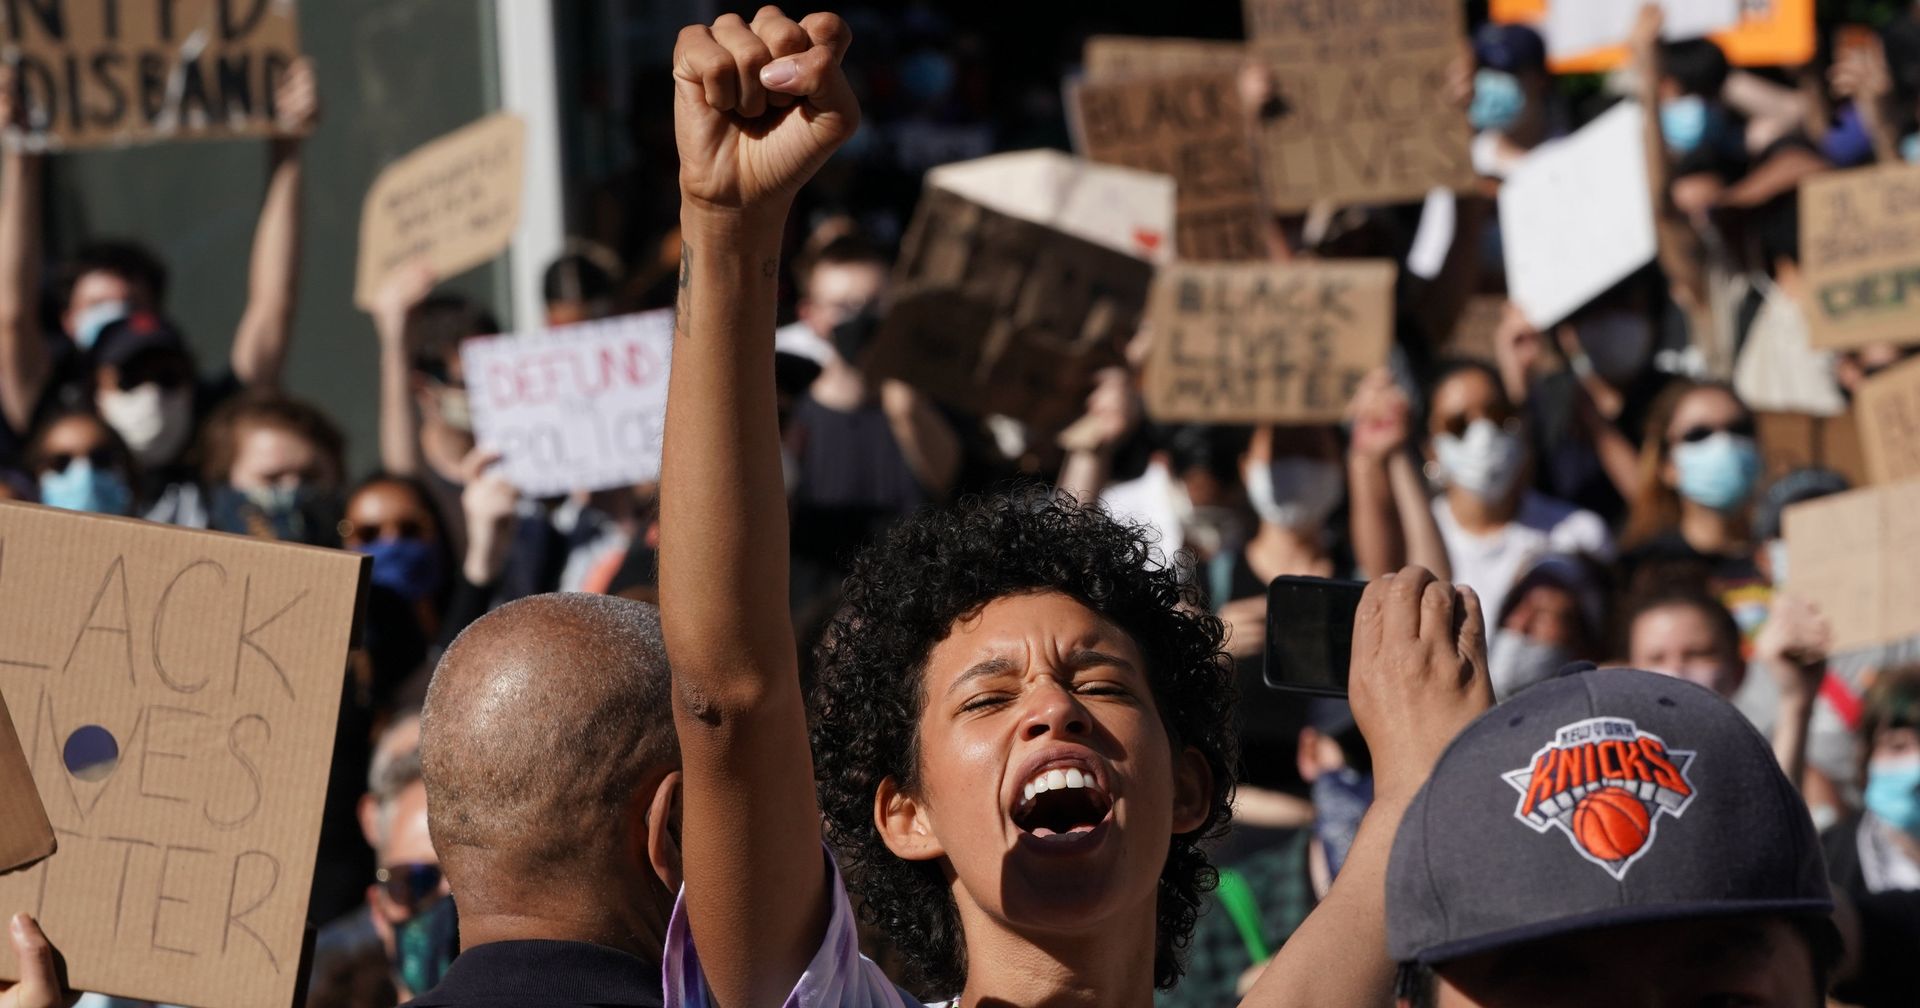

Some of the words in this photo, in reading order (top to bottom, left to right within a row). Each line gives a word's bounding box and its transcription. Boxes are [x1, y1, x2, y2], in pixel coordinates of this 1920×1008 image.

[1176, 274, 1356, 325] BLACK
[487, 340, 661, 412] DEFUND
[1170, 322, 1334, 370] LIVES
[1522, 736, 1692, 817] KNICKS
